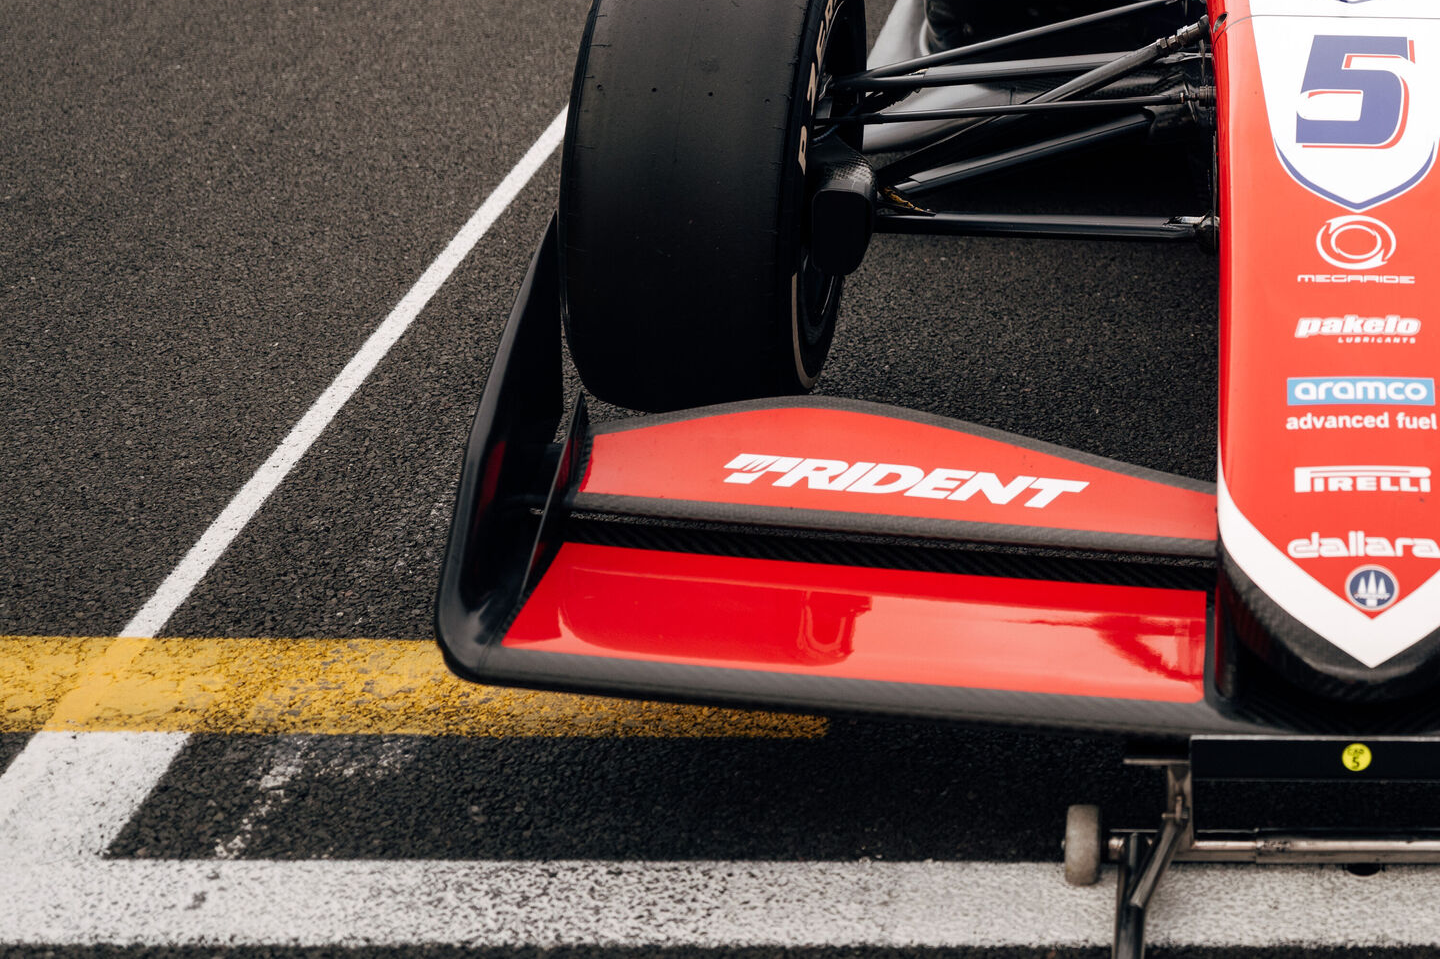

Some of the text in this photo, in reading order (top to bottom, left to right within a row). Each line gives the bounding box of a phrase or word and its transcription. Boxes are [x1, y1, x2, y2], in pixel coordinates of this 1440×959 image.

[1296, 34, 1415, 150] 5
[1297, 274, 1416, 284] MEGARIDE
[1294, 314, 1422, 339] pakelo
[1337, 336, 1417, 345] LUBRICANTS
[1294, 381, 1428, 401] aramco
[1285, 411, 1438, 431] advanced fuel
[723, 453, 1090, 509] TRIDENT
[1294, 465, 1432, 493] PIRELLI
